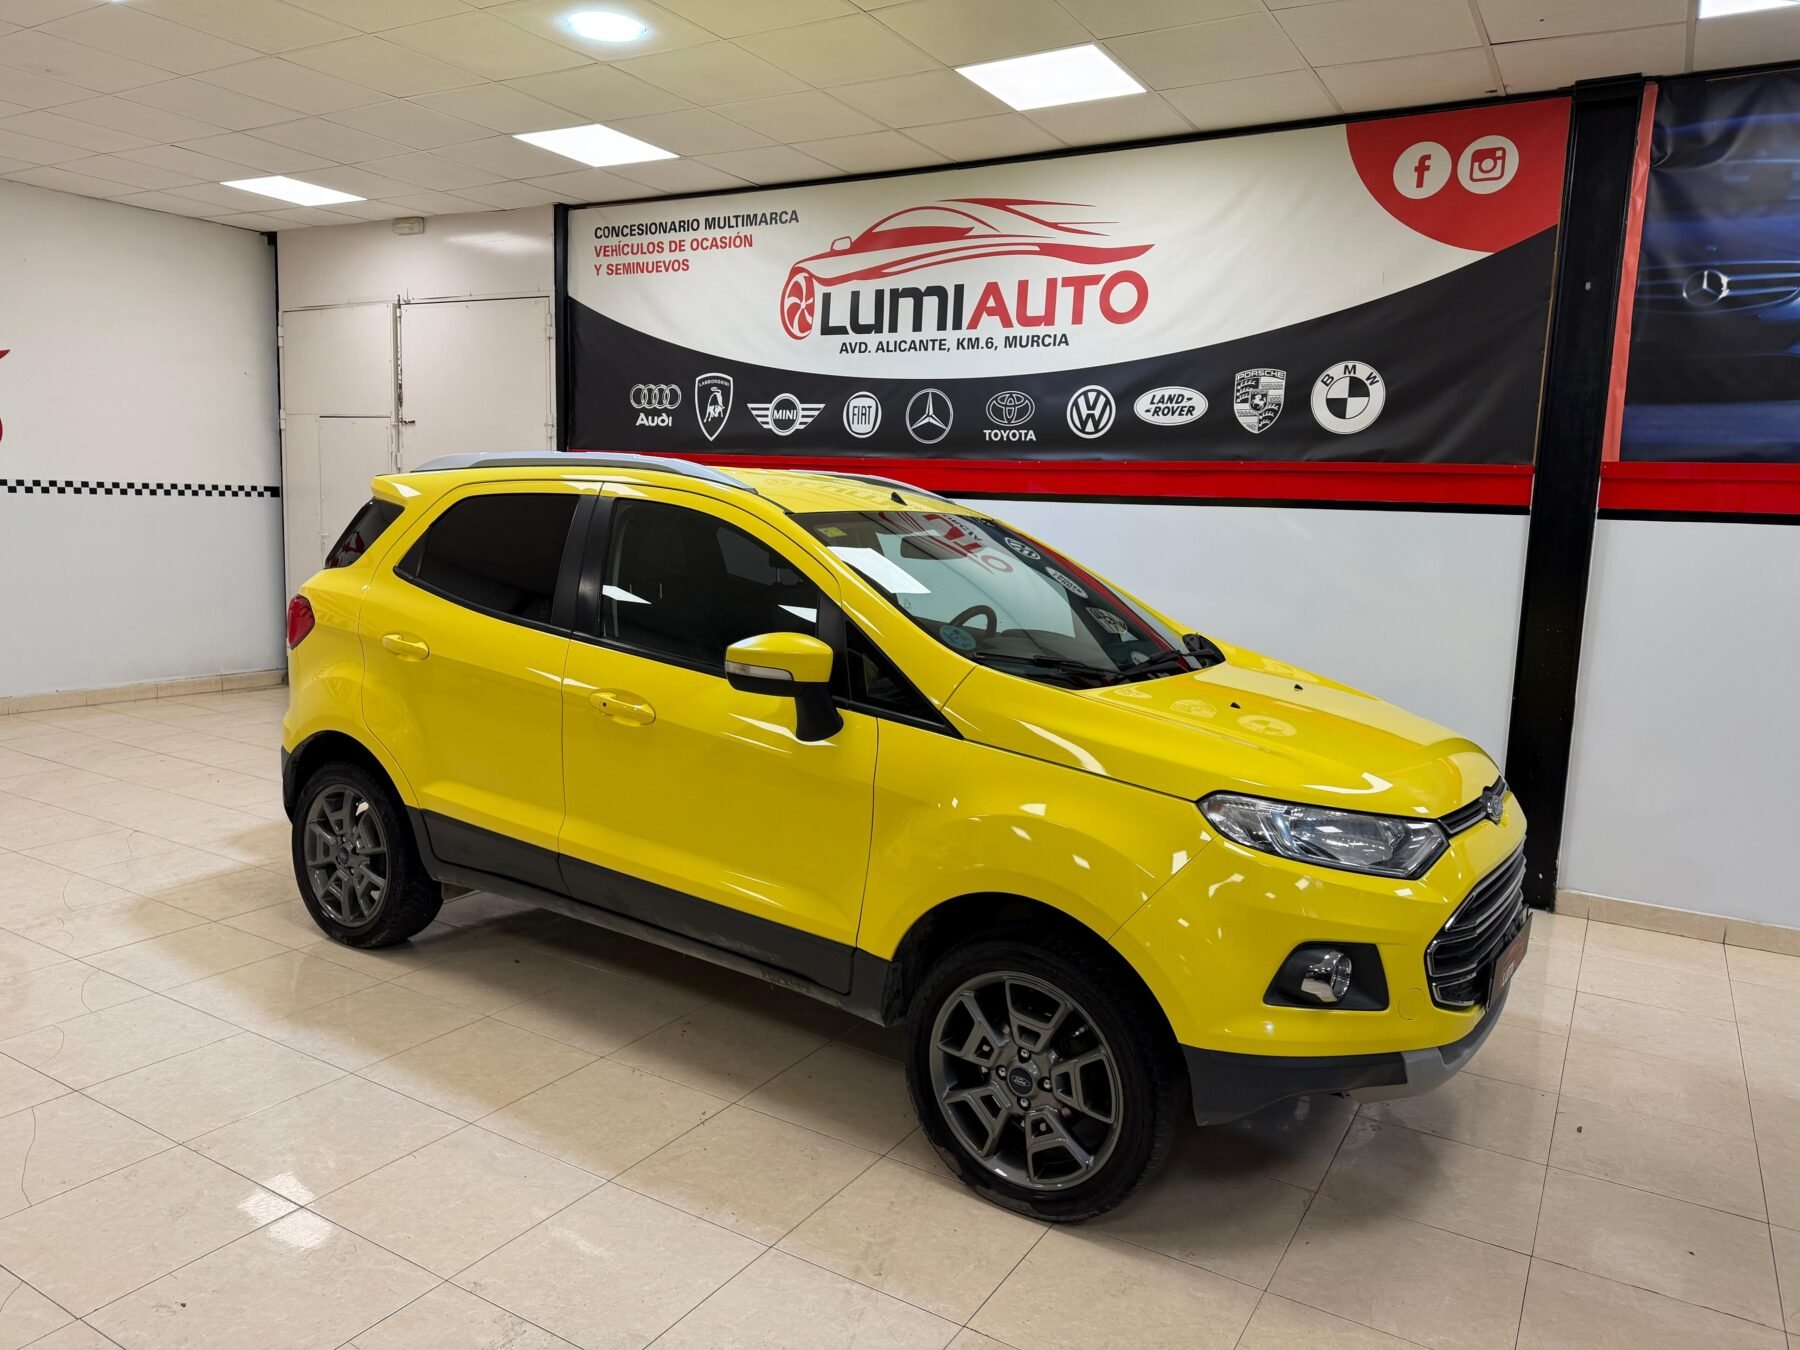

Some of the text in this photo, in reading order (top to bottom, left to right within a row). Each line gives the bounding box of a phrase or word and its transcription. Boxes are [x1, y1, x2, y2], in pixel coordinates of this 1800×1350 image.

[594, 210, 799, 239] CONCESIONARIO MULTIMARCA
[594, 232, 753, 258] VEHÍCULOS DE OCASIÓN
[594, 258, 690, 276] Y SEMINUEVOS
[839, 333, 1070, 355] AVD. ALICANTE, KM.6, MURCIA
[1236, 370, 1285, 381] PORSCHE
[635, 412, 673, 427] Audi
[773, 409, 797, 421] MINI
[852, 404, 872, 426] FIAT
[983, 429, 1037, 442] TOYOTA
